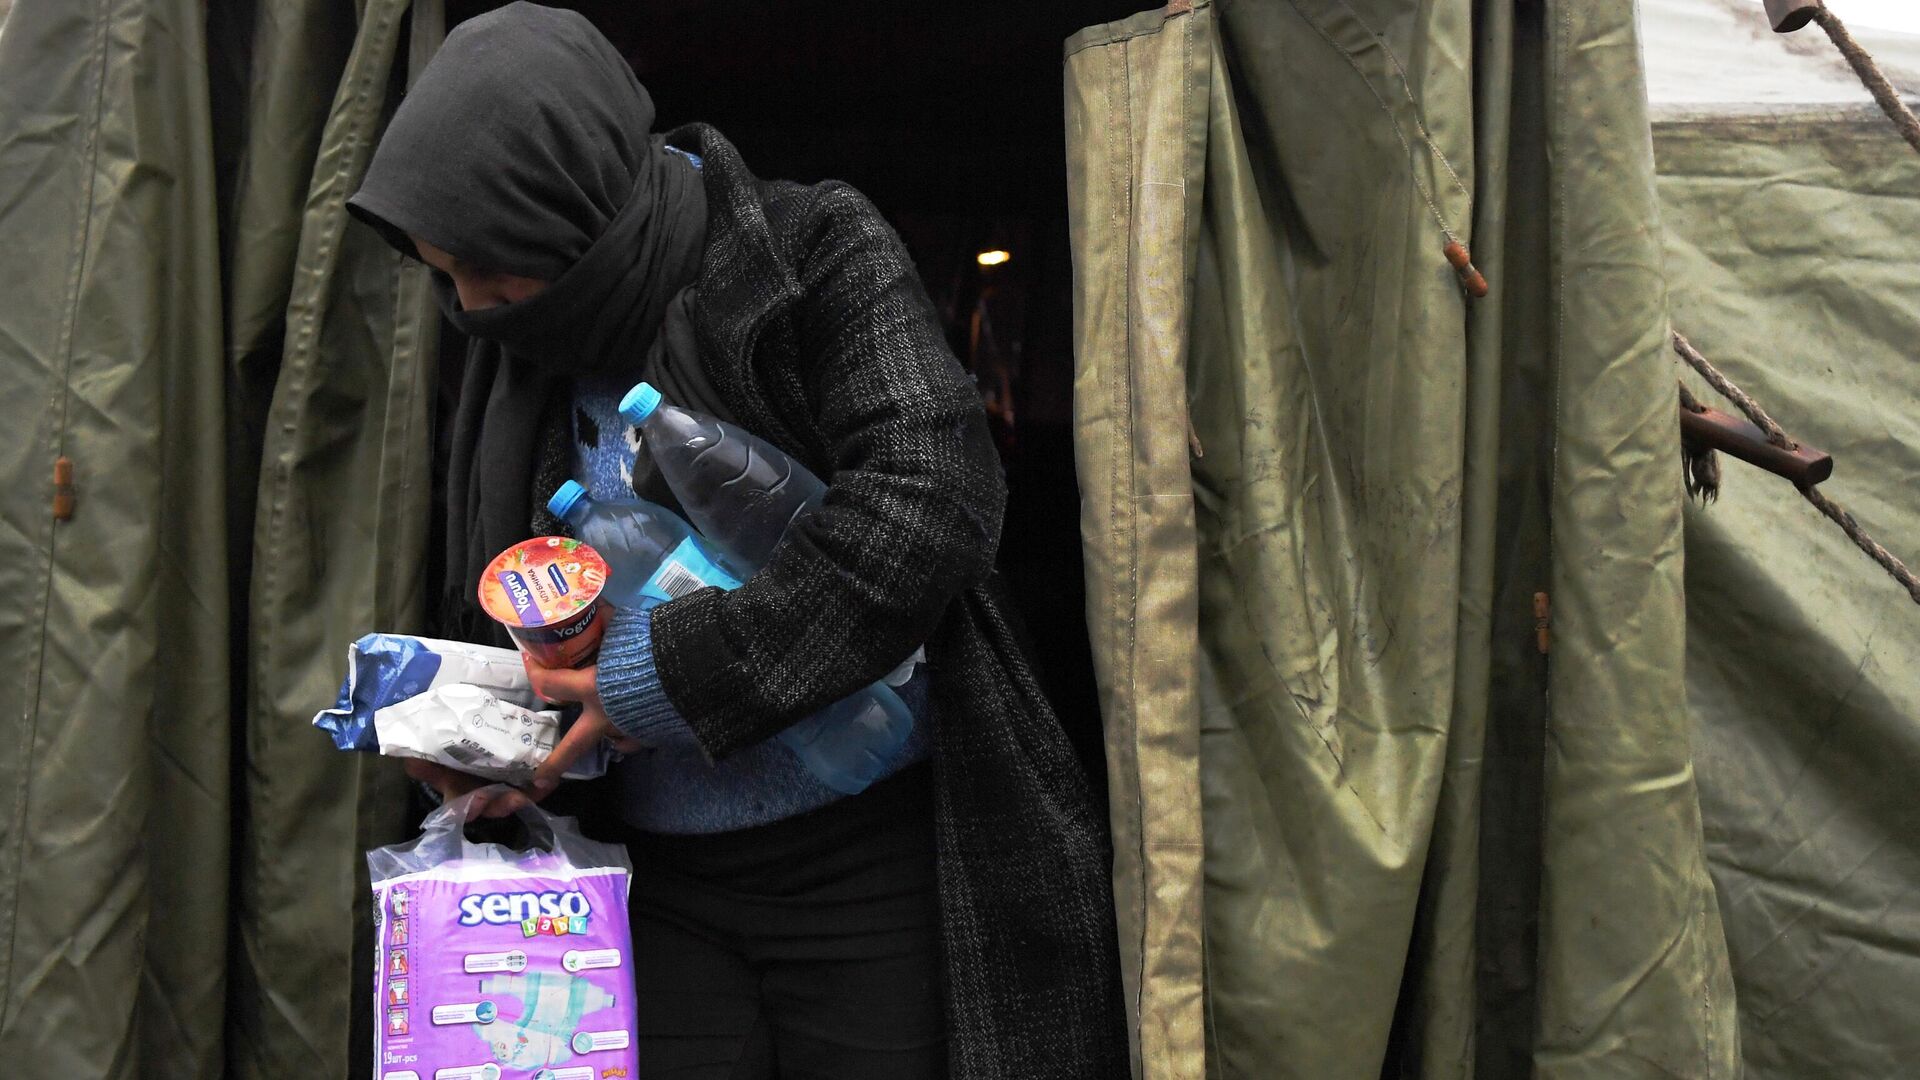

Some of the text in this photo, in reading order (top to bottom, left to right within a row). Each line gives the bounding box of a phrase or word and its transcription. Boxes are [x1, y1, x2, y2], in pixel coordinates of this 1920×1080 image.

[505, 573, 531, 615] Yoguru
[527, 568, 550, 603] КЛУБНИКА
[458, 890, 592, 926] senso
[523, 917, 586, 936] baby
